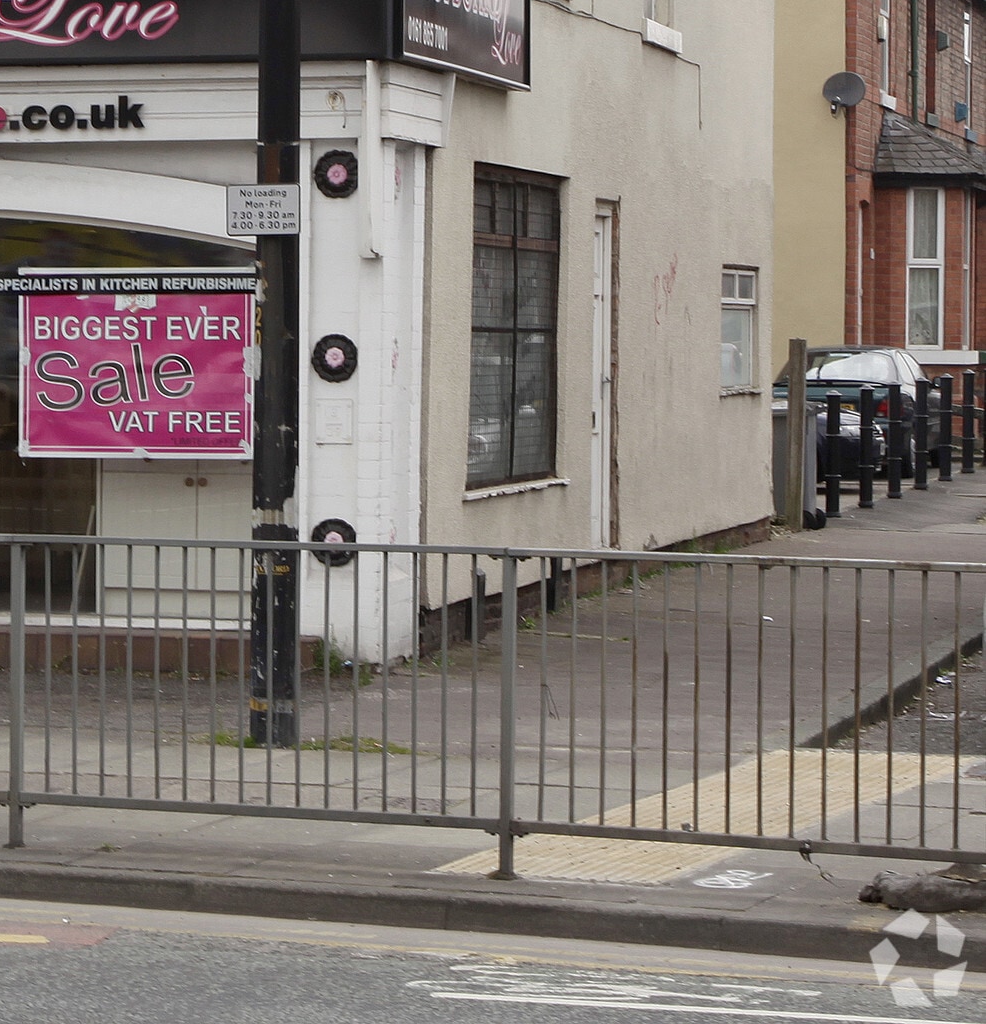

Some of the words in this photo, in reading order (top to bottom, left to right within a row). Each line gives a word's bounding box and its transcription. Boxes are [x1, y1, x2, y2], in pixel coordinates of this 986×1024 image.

[239, 189, 253, 197] No
[254, 189, 287, 198] loading
[81, 278, 96, 291] IN
[100, 278, 159, 291] KITCHEN
[163, 277, 256, 291] REFURBISHME
[34, 316, 156, 341] BIGGEST
[166, 316, 241, 341] EVER
[34, 343, 196, 412] Sale
[108, 411, 159, 434] VAT
[168, 411, 242, 434] FREE
